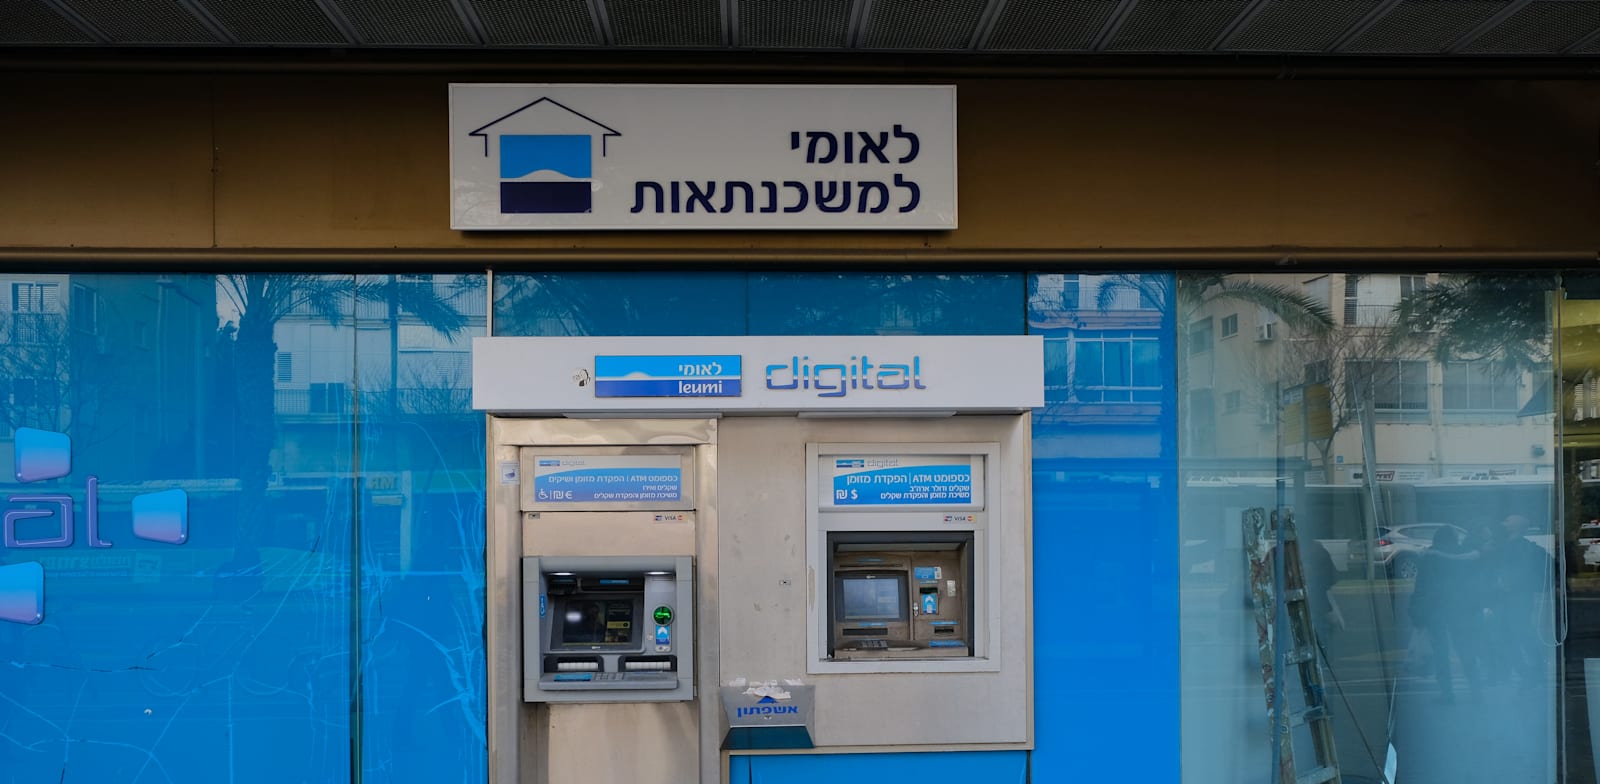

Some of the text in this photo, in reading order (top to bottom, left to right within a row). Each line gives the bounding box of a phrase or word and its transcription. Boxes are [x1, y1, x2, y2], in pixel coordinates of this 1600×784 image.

[790, 124, 920, 165] לאומי
[630, 173, 921, 214] למשכנתאות
[678, 361, 723, 376] לאומי
[766, 356, 926, 397] digital
[678, 380, 723, 394] leumi
[847, 474, 970, 485] כספומט ATM הפקדת מזומן
[737, 705, 799, 719] אשפתון
